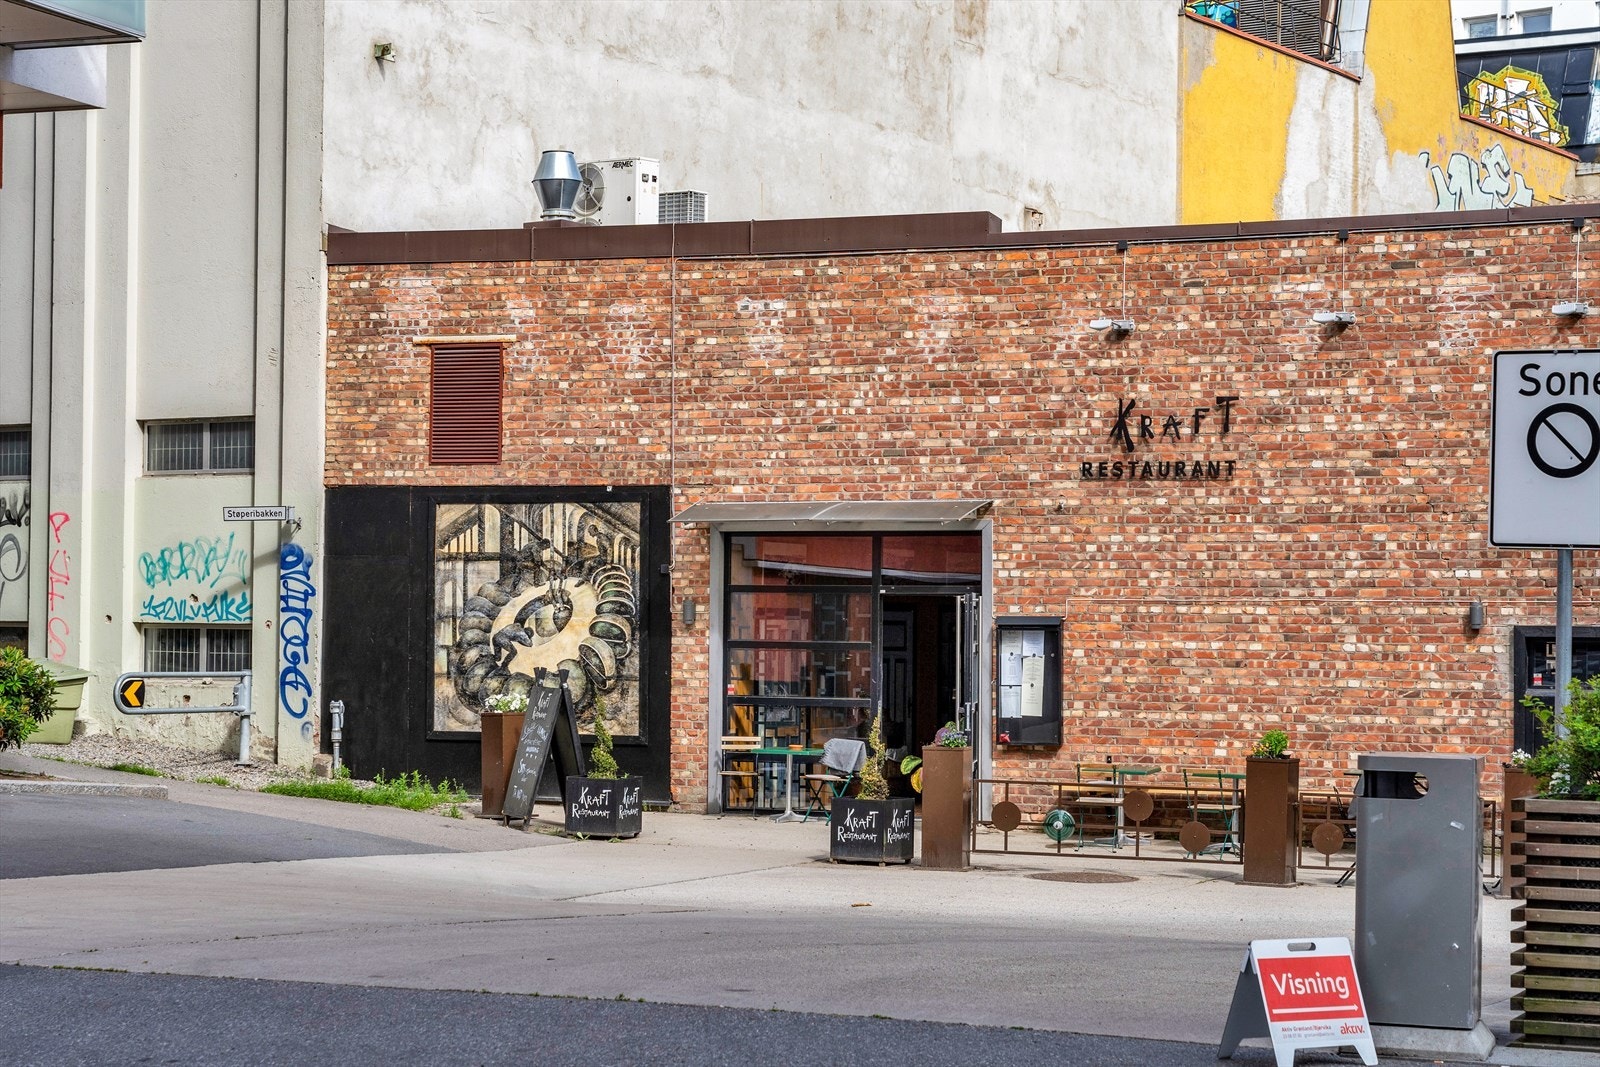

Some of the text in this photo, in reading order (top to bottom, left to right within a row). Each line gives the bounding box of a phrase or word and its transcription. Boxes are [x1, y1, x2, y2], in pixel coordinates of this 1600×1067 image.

[611, 160, 633, 169] AERMEC
[1109, 396, 1239, 452] KRAFT
[1082, 461, 1236, 479] RESTAURANT
[227, 509, 283, 519] Støperibakken
[1270, 971, 1350, 999] Visning
